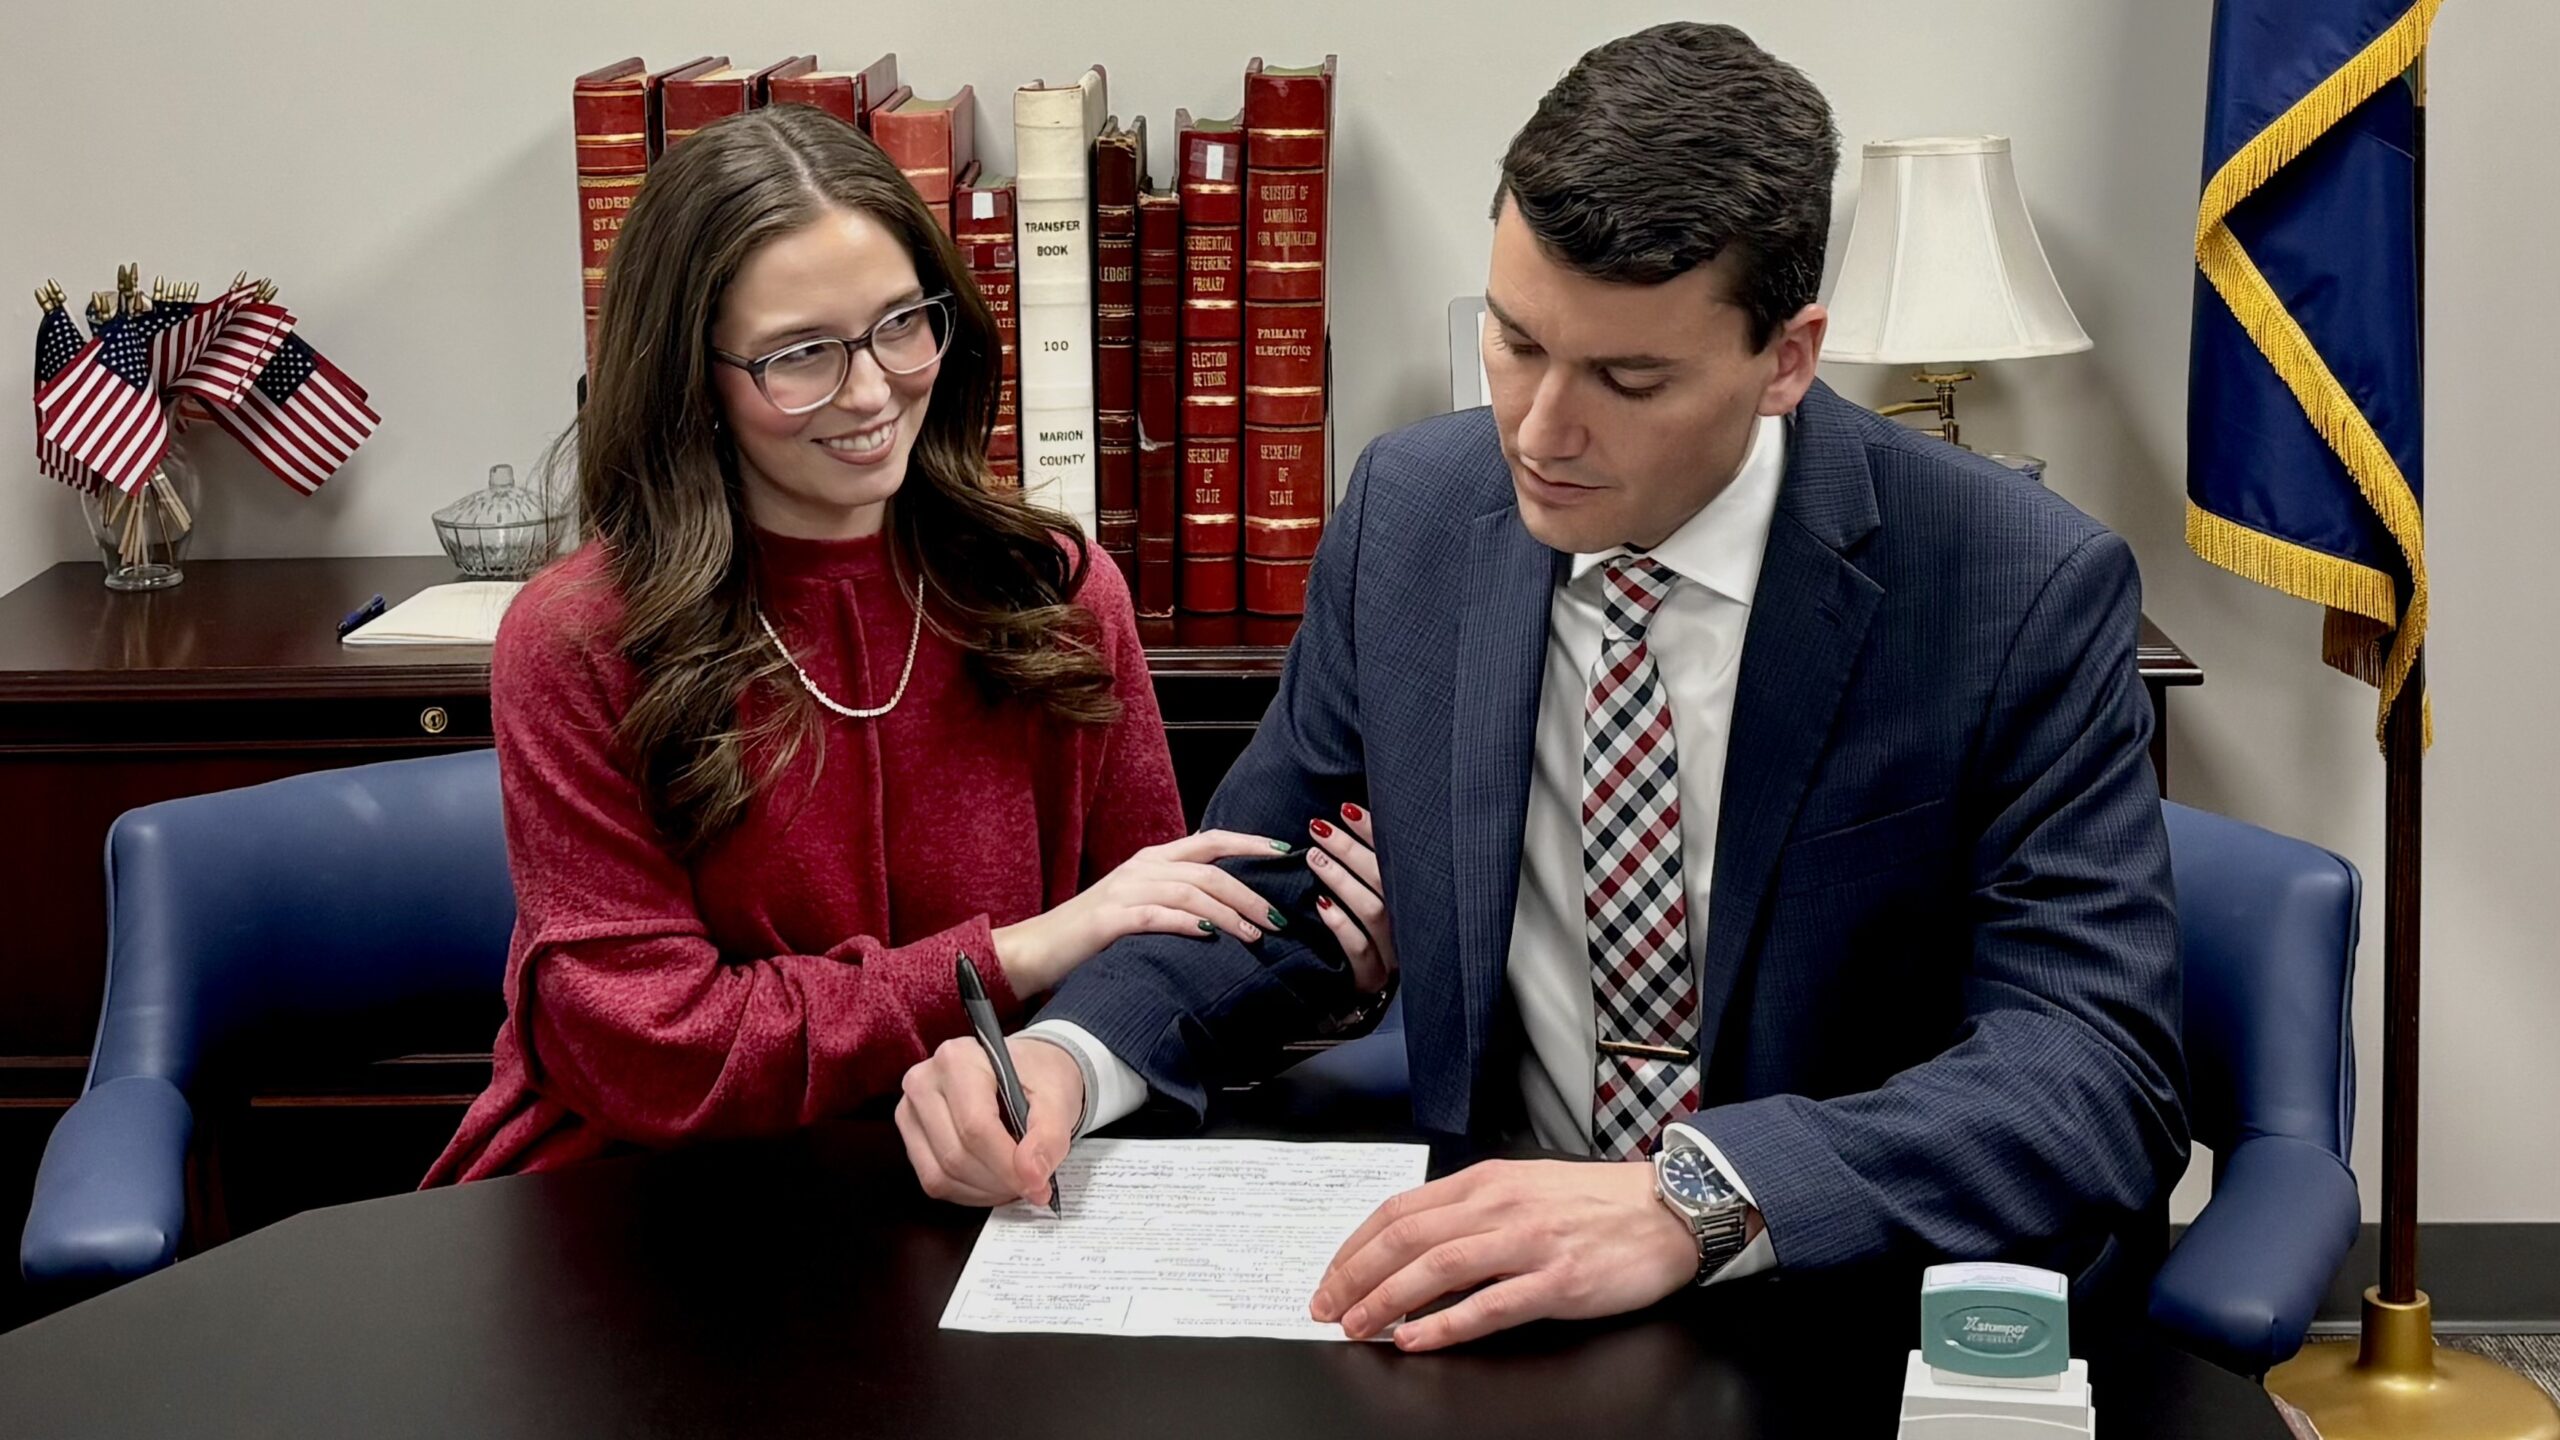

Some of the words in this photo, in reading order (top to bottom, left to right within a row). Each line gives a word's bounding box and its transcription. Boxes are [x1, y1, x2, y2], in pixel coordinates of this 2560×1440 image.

[1261, 185, 1296, 201] REGISTER
[1300, 185, 1308, 201] OF
[1263, 208, 1307, 224] CANDIDATES
[1025, 220, 1081, 233] TRANSFER
[1037, 245, 1068, 257] BOOK
[1257, 328, 1307, 339] PRIMARY
[1044, 340, 1069, 352] 100
[1255, 345, 1312, 357] ELECTIONS
[1192, 351, 1228, 368] ELECTION
[1039, 430, 1084, 442] MARION
[1039, 453, 1086, 466] COUNTY
[1187, 448, 1230, 464] SECRETARY
[1260, 444, 1302, 460] SECRETARY
[1204, 468, 1214, 484] OF
[1278, 466, 1289, 482] OF
[1195, 488, 1221, 504] STATE
[1269, 489, 1294, 506] STATE
